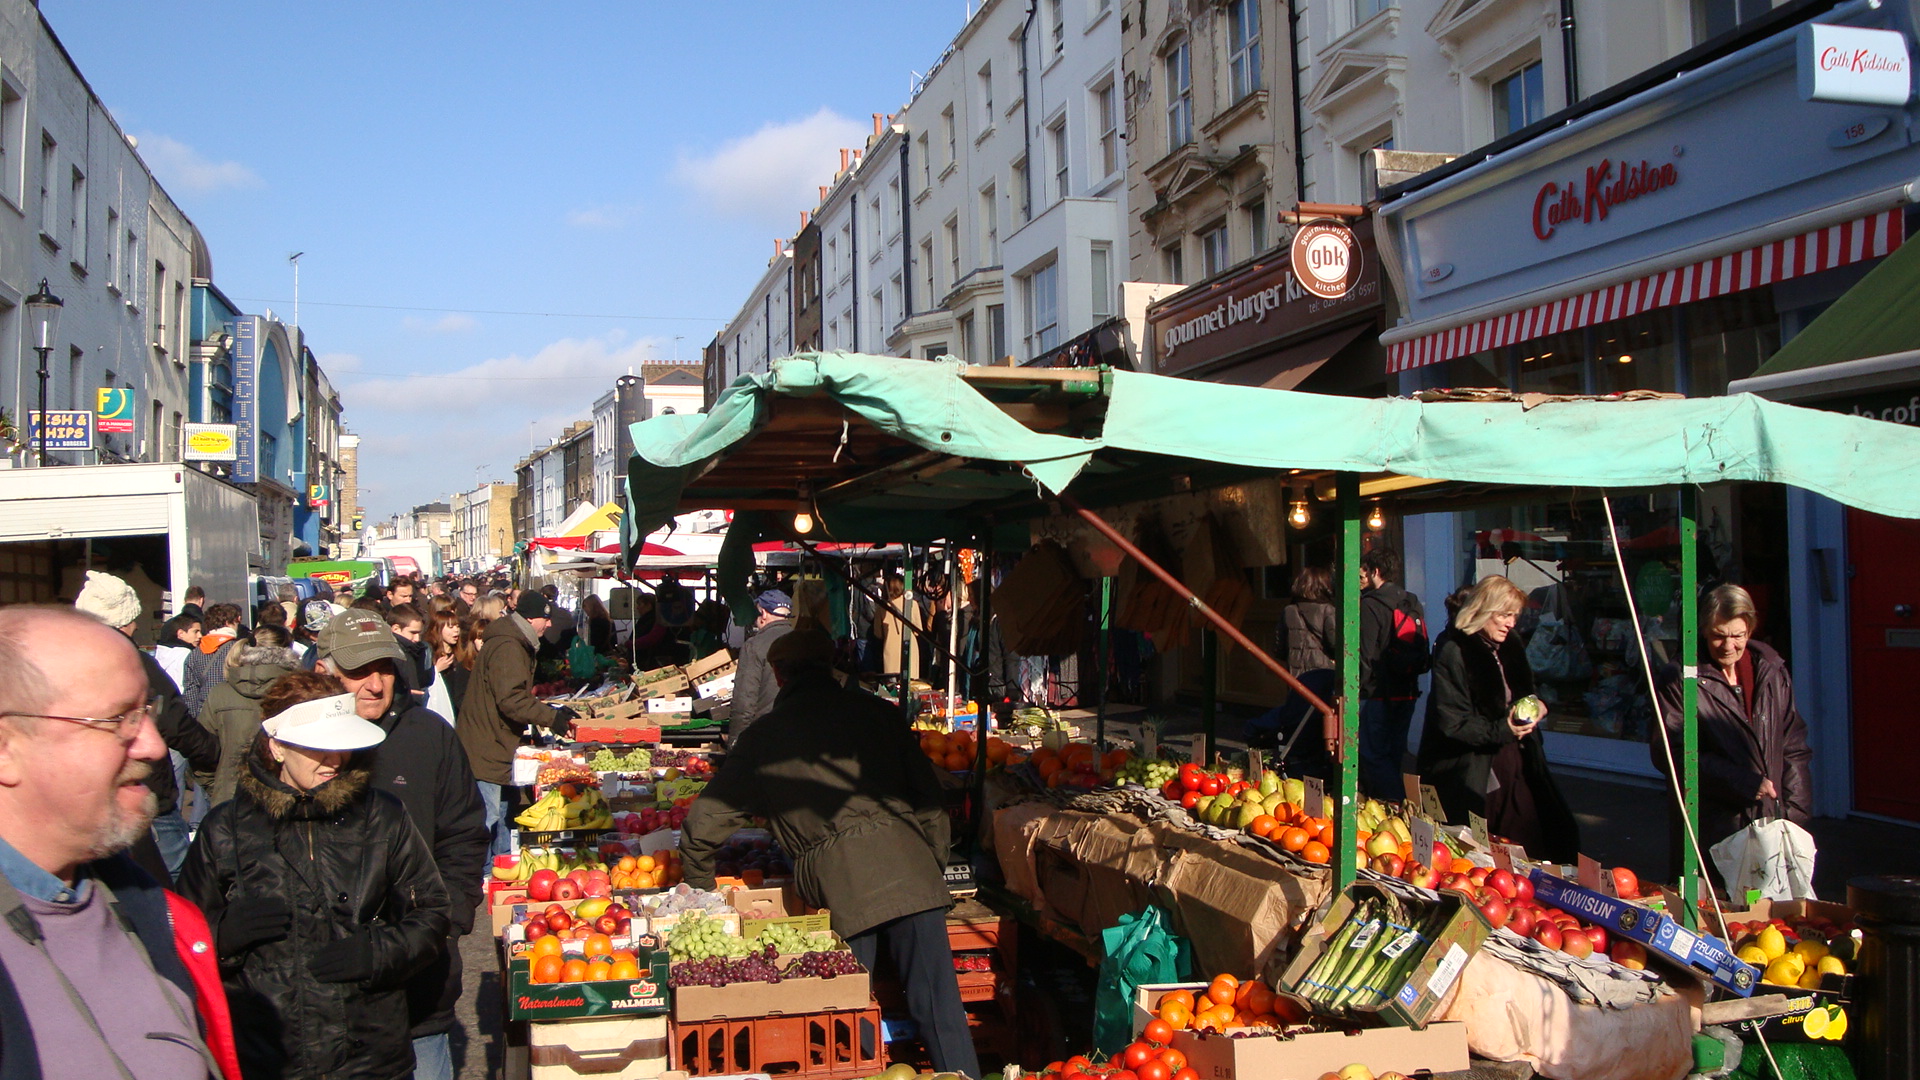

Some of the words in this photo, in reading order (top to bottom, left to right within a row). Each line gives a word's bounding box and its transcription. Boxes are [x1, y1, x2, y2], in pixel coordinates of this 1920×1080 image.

[1820, 46, 1850, 71] Cath
[1851, 49, 1902, 74] Kidston
[1844, 123, 1865, 140] 158
[1532, 181, 1582, 241] Cath
[1583, 158, 1678, 224] Kidston
[1311, 245, 1345, 270] gbk
[1314, 280, 1347, 293] kitchen
[1164, 304, 1226, 358] gourmet
[1227, 282, 1283, 324] burger
[235, 321, 252, 477] ELECTRIC
[76, 414, 87, 426] &
[1560, 888, 1613, 919] KIWISUN
[1694, 939, 1735, 968] FRUITSUN
[518, 995, 585, 1010] Naturalmente
[611, 997, 665, 1009] PALMERI
[1400, 986, 1413, 1000] 16
[1781, 1015, 1805, 1025] citrus
